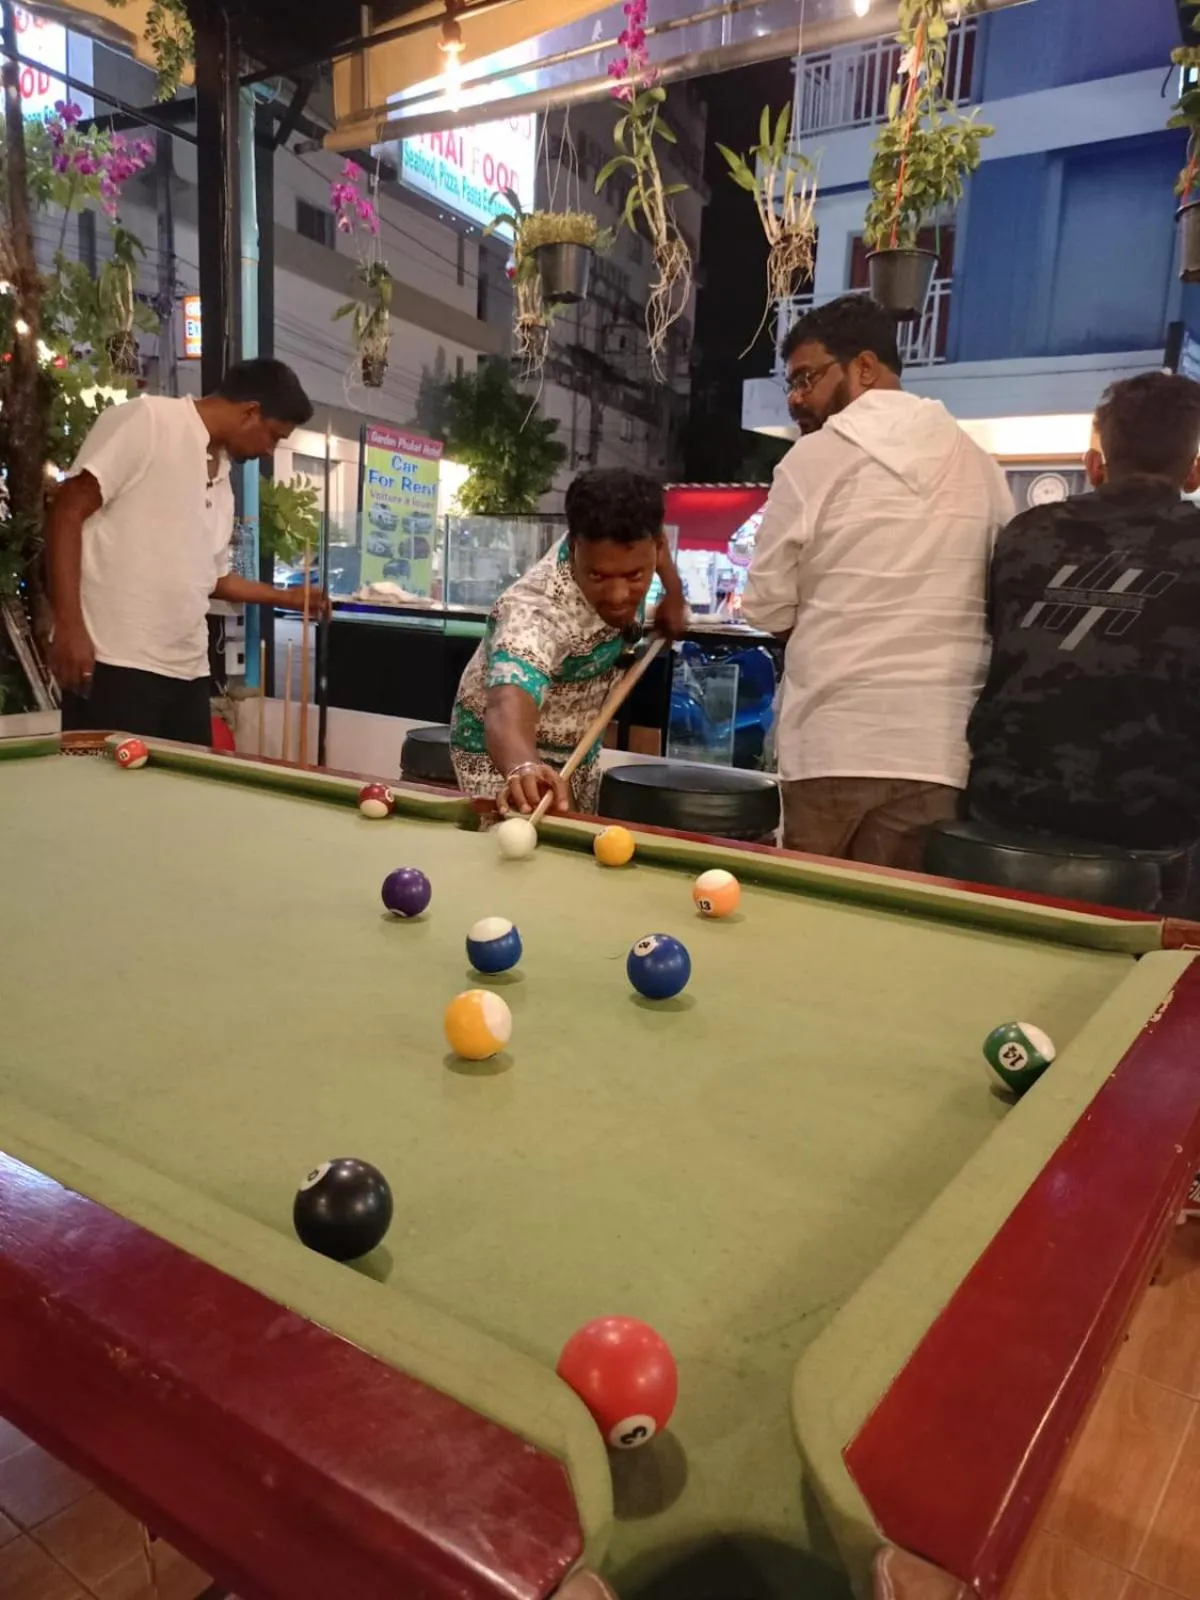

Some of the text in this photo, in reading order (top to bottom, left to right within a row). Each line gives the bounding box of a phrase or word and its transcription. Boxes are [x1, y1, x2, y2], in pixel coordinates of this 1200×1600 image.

[420, 130, 463, 168] HAI
[398, 436, 422, 453] Phuket
[391, 455, 418, 474] Car
[368, 469, 436, 497] For Rent
[699, 900, 711, 911] 13
[620, 1425, 647, 1445] 3
